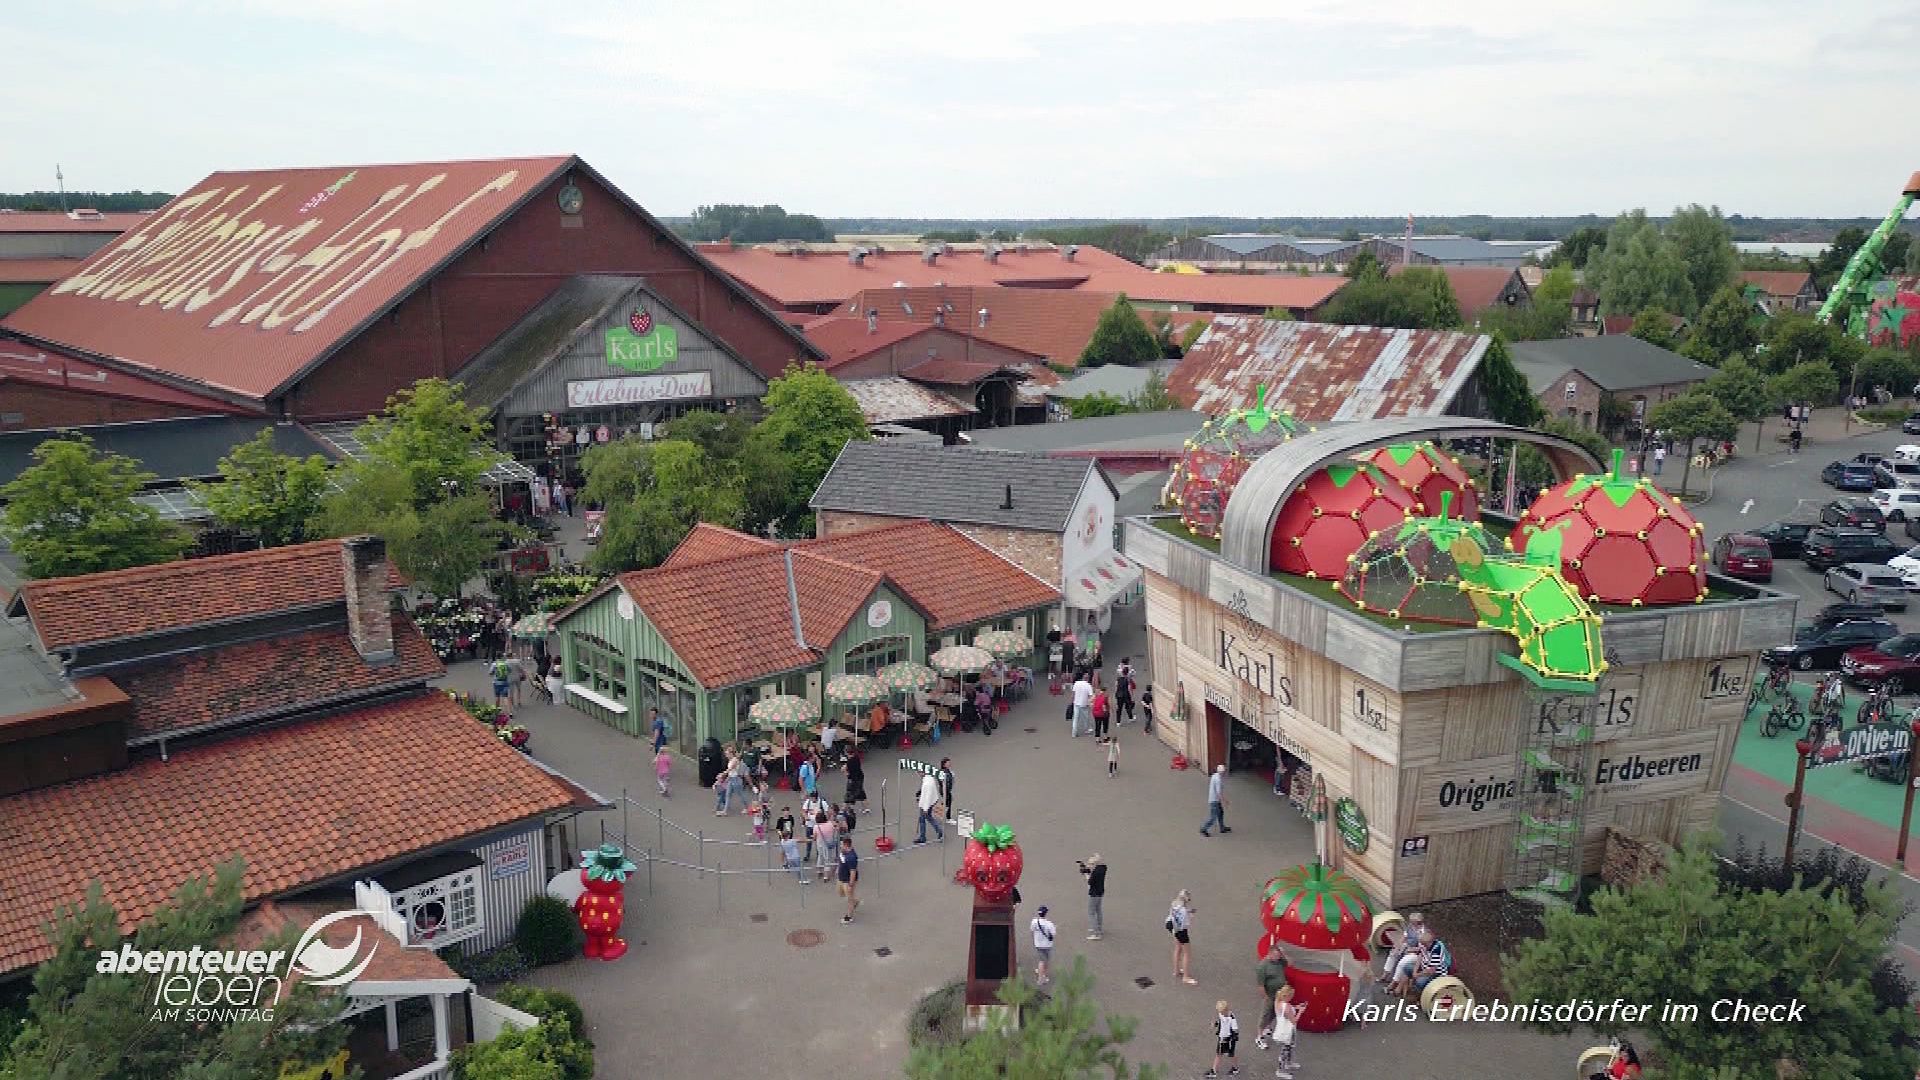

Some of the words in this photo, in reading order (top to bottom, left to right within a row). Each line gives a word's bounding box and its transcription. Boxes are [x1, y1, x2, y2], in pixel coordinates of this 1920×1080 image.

[610, 333, 674, 361] Karls
[570, 375, 706, 404] Erlebnis-Dorf
[1218, 629, 1292, 706] Karls
[1708, 664, 1742, 695] 1kg
[1356, 688, 1383, 730] 1kg
[1537, 688, 1633, 734] Karls
[900, 758, 945, 780] TICKETS
[1439, 775, 1518, 811] Origina
[1594, 752, 1702, 785] Erdbeeren
